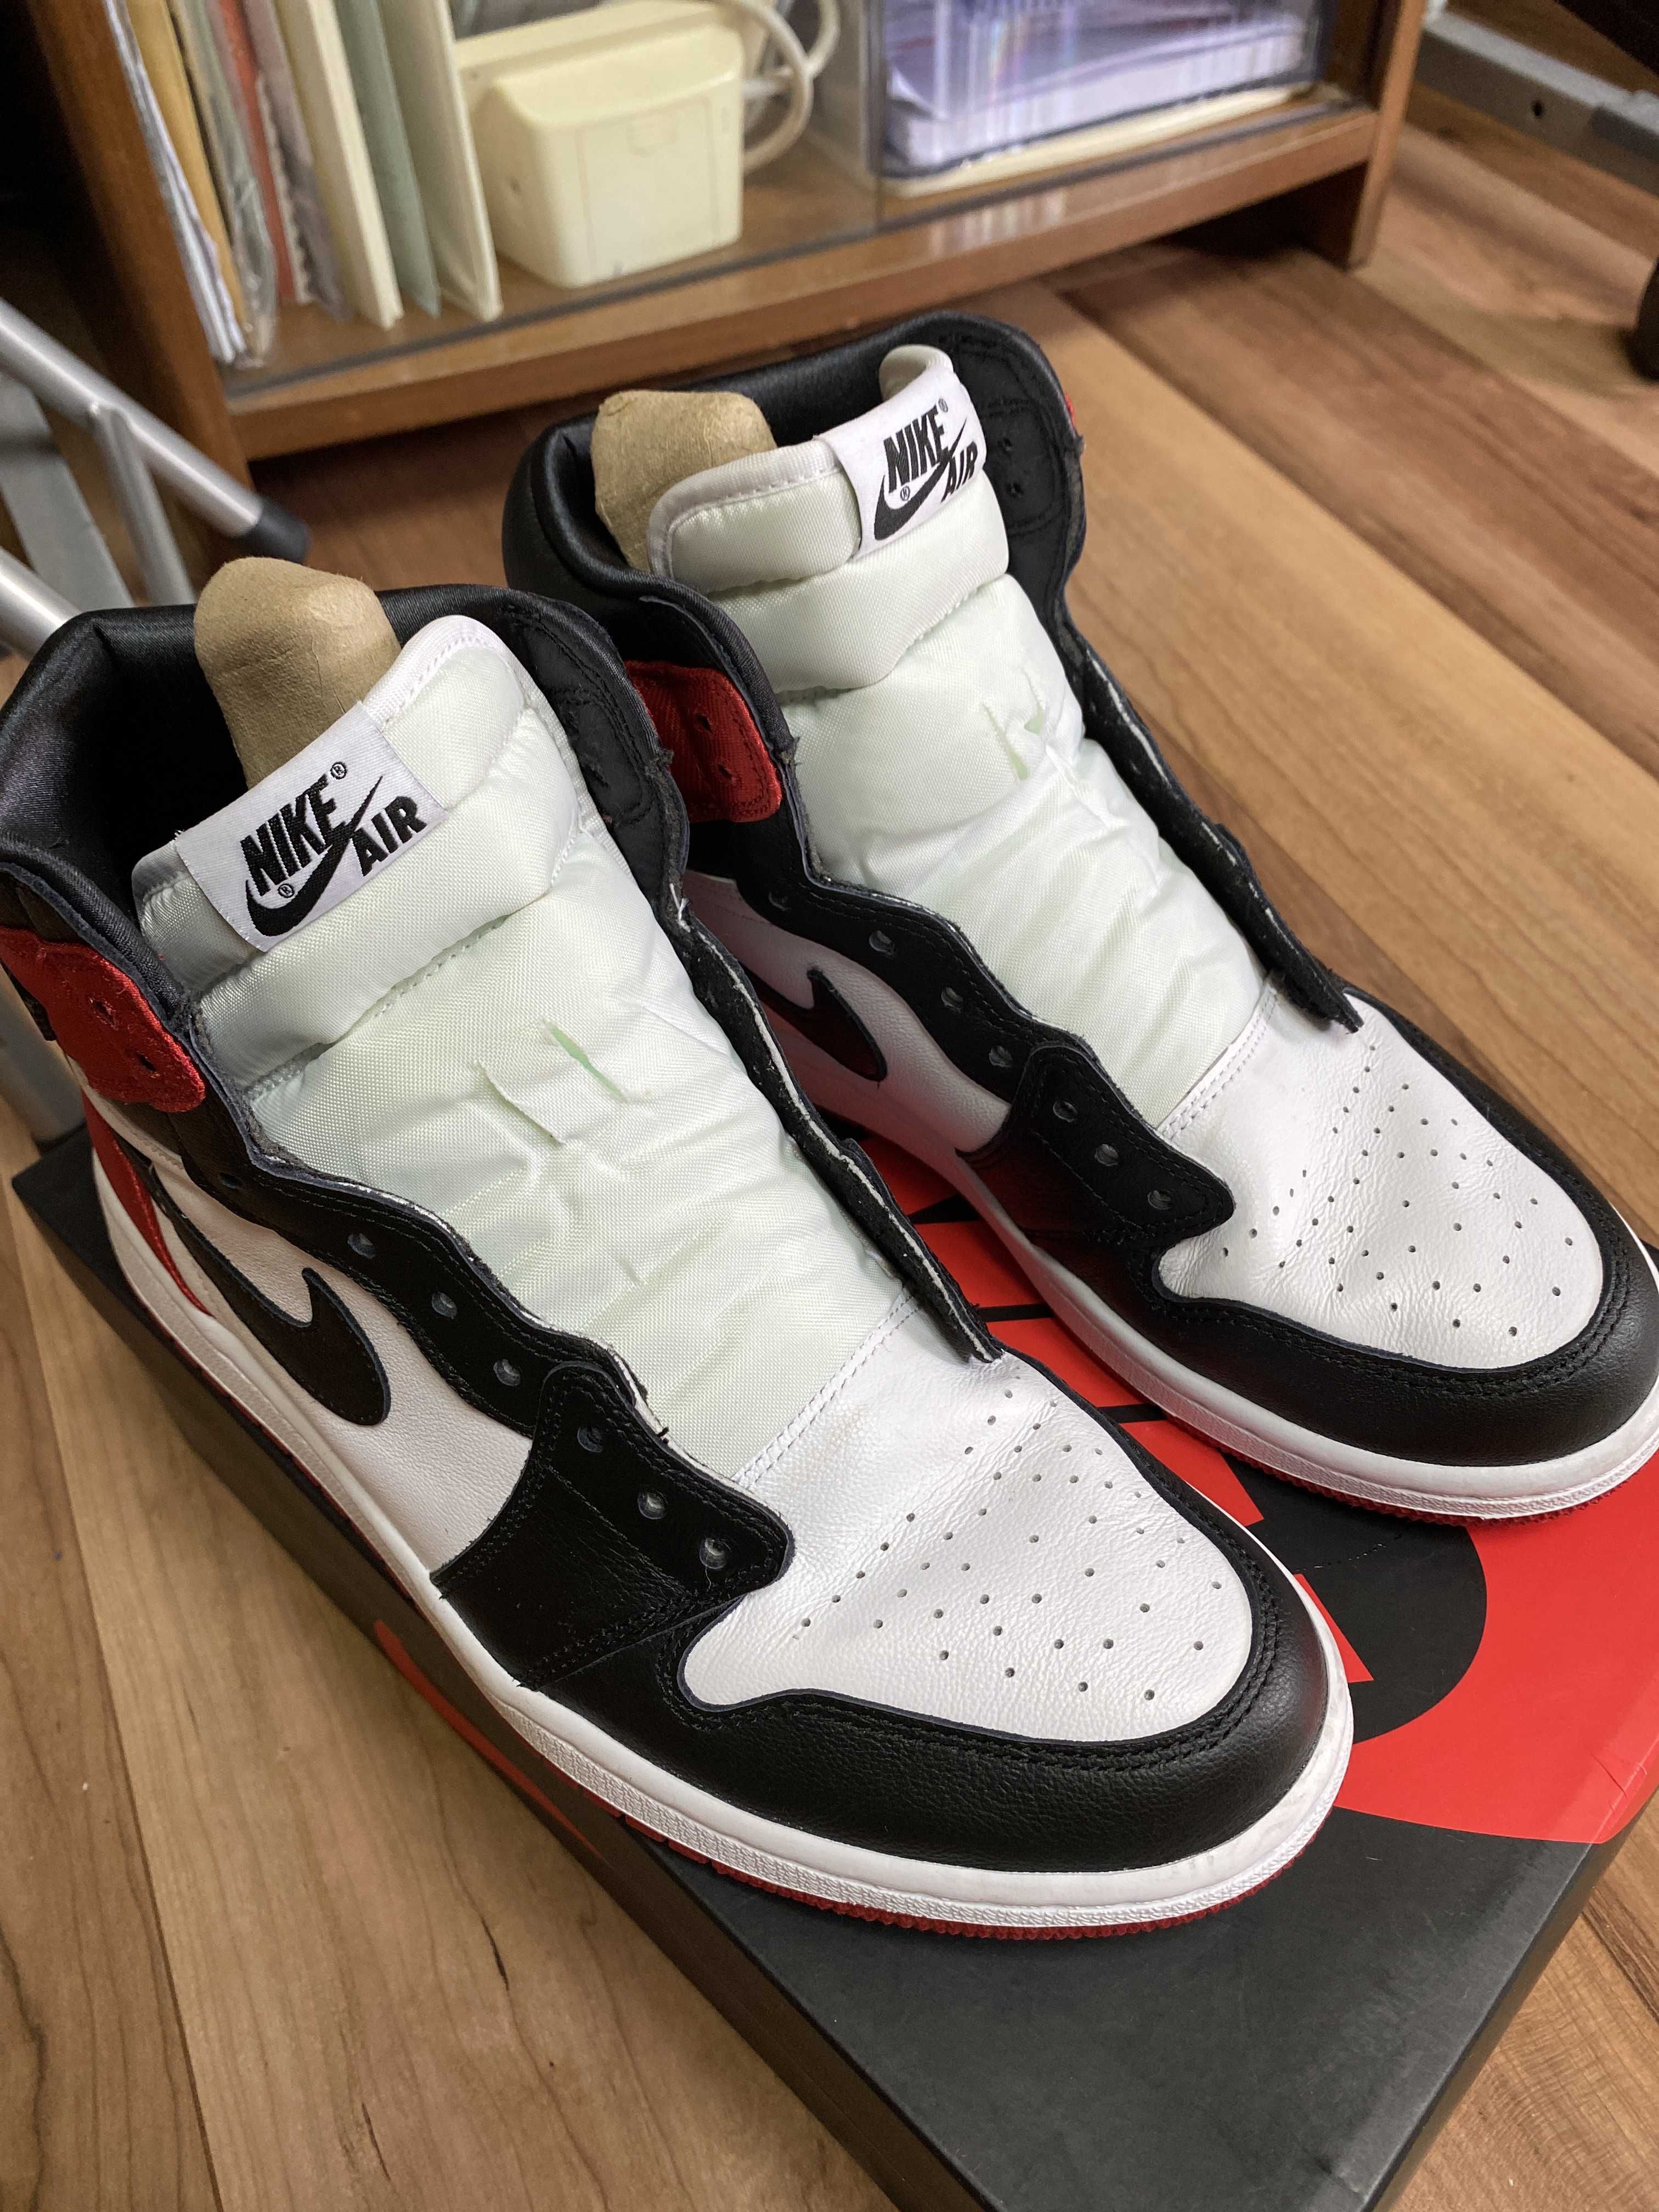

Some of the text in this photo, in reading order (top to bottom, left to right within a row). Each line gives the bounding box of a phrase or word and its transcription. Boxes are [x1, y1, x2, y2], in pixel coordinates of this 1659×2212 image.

[883, 405, 949, 493] NIKE
[941, 441, 978, 503] AIR
[240, 774, 347, 896] NIKE
[351, 796, 427, 876] AIR
